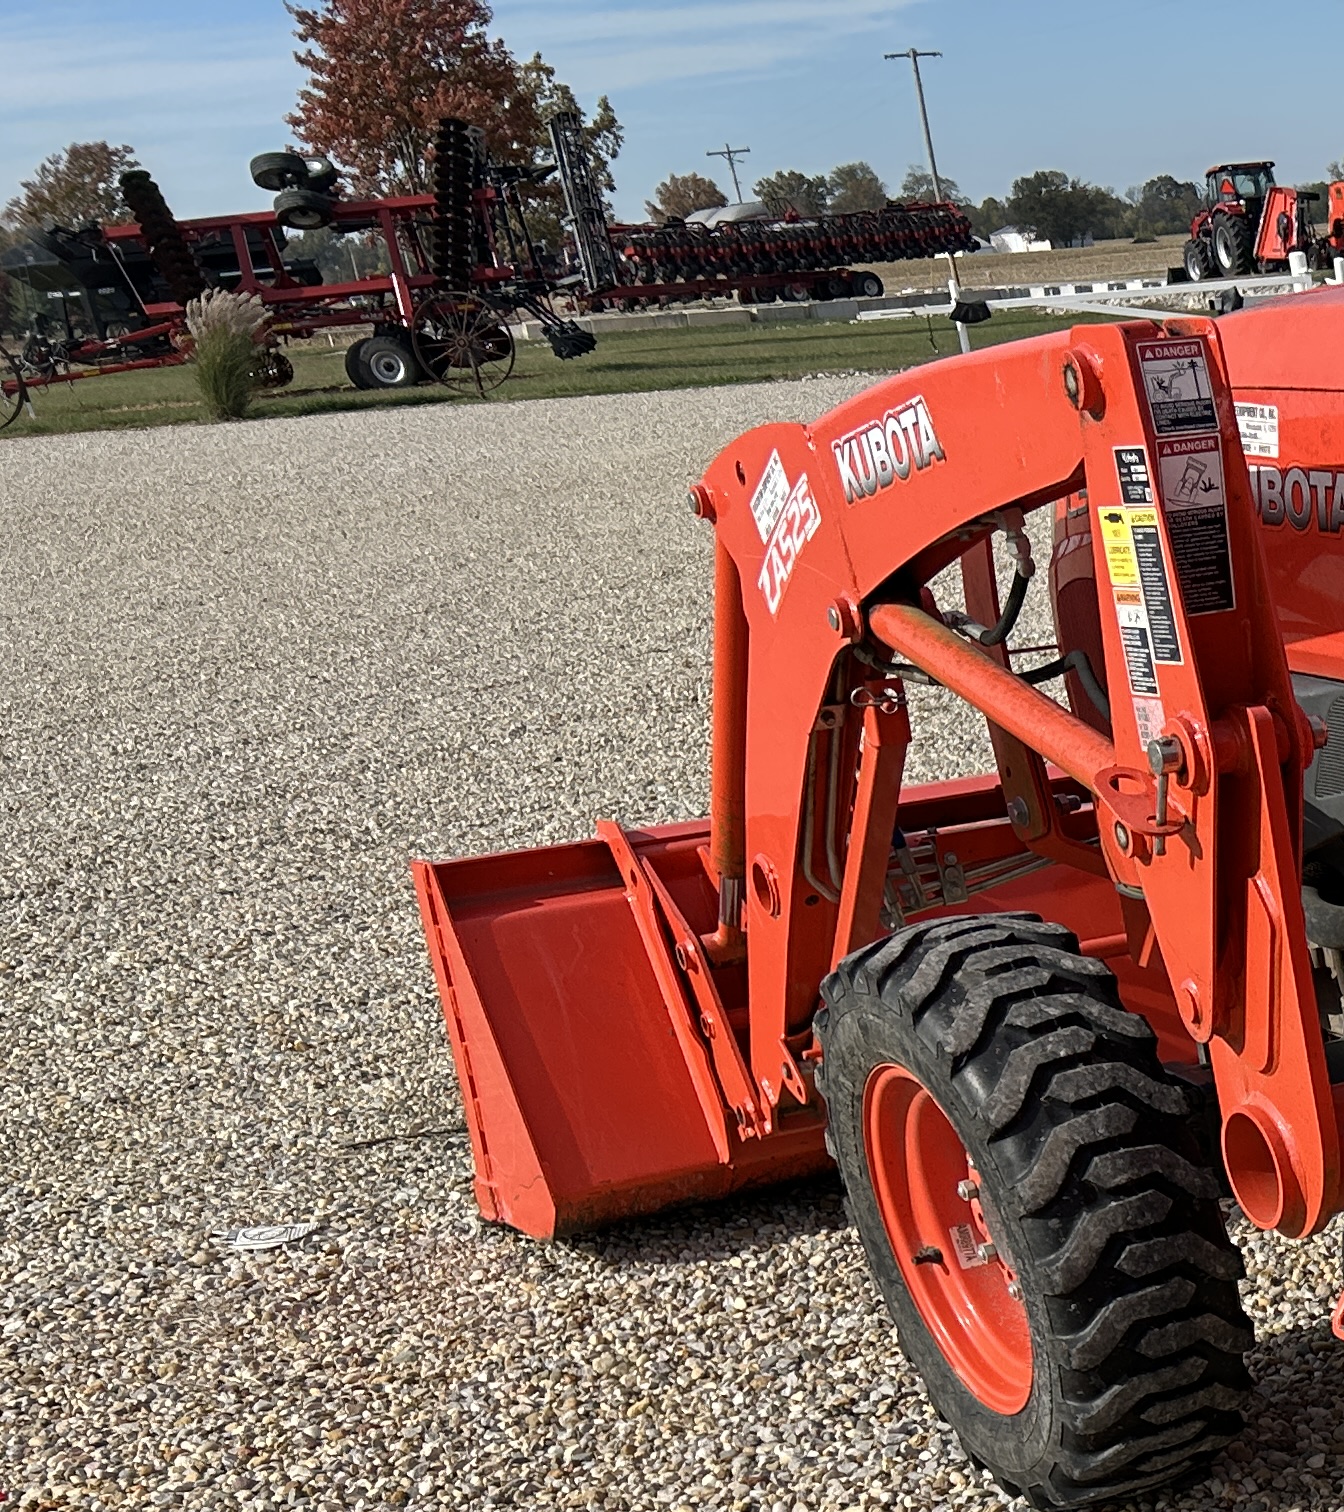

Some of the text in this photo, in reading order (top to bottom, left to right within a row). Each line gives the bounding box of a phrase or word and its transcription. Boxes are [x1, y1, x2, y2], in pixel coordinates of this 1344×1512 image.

[1155, 345, 1199, 359] DANGER
[833, 400, 947, 505] KUBOTA
[1173, 440, 1216, 453] DANGER
